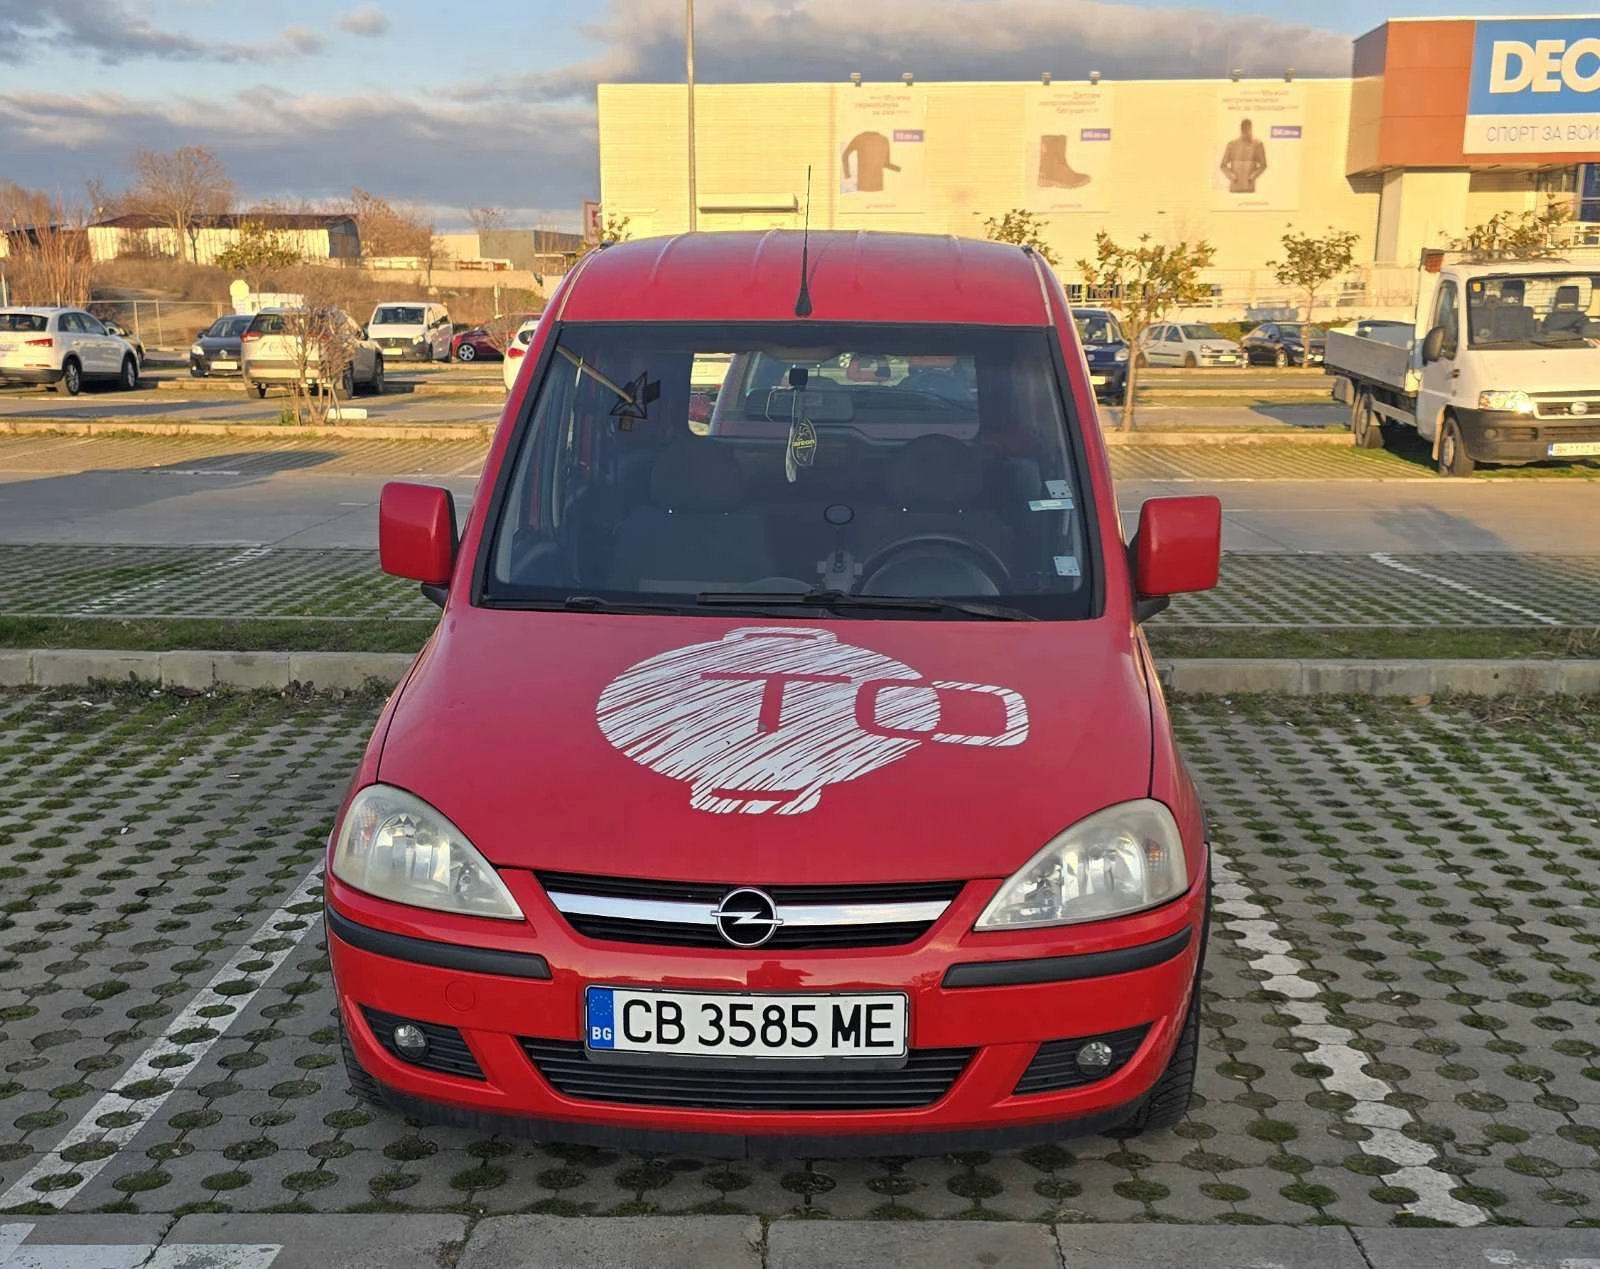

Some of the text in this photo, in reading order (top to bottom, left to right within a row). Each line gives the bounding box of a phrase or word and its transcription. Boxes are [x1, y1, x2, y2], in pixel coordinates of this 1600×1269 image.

[1487, 126, 1538, 142] СПОРТ
[1542, 126, 1562, 141] ЗА
[622, 998, 895, 1048] CB 3585 ME
[591, 1027, 612, 1040] BG
